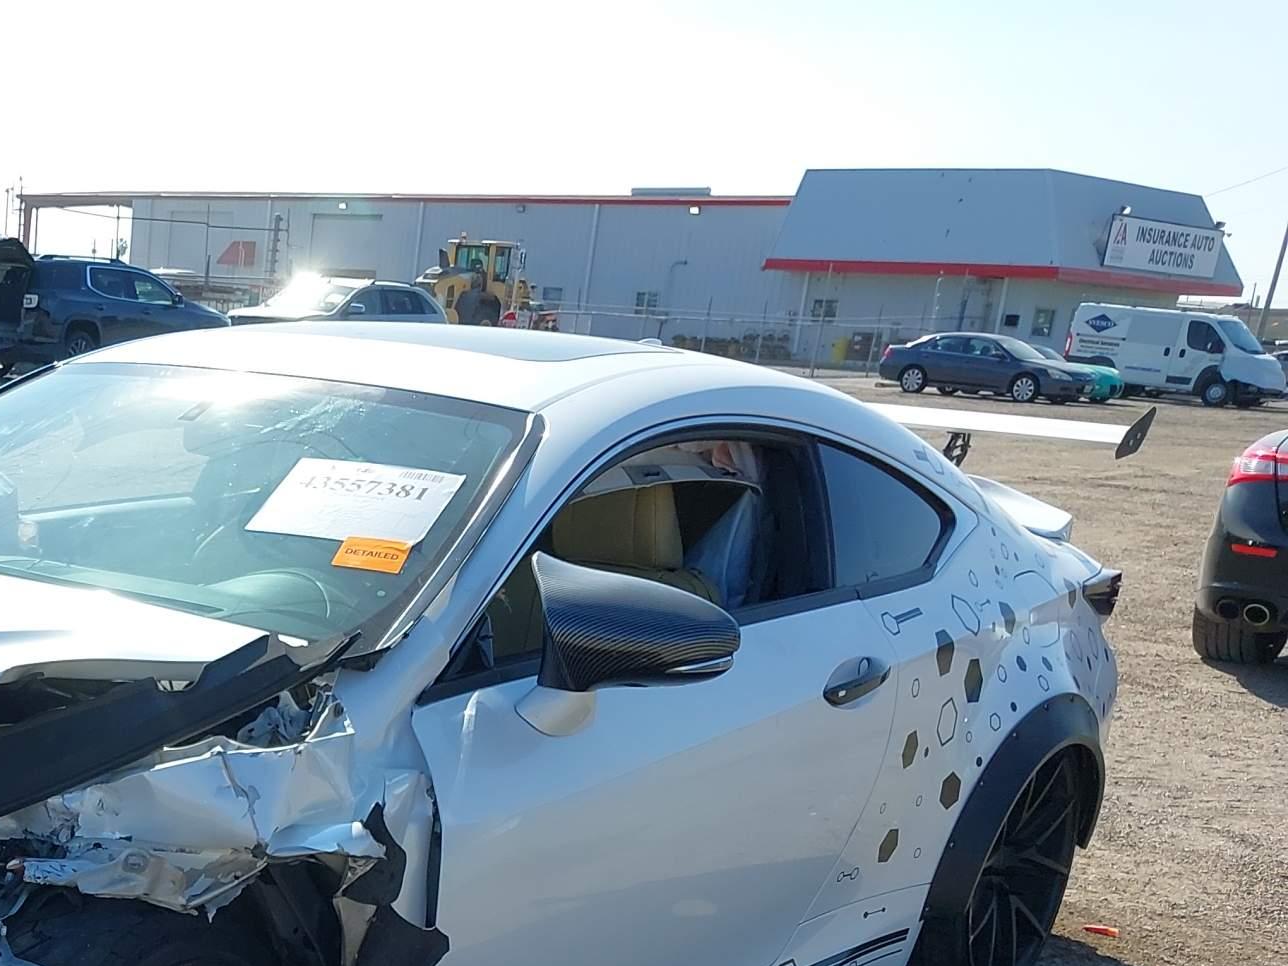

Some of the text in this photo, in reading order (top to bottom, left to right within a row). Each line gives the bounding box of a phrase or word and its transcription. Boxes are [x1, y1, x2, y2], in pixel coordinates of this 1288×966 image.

[1135, 226, 1215, 252] INSURANCE AUTO
[1148, 249, 1195, 269] AUCTIONS
[300, 476, 430, 501] 43557381
[344, 547, 399, 561] DETAILED
